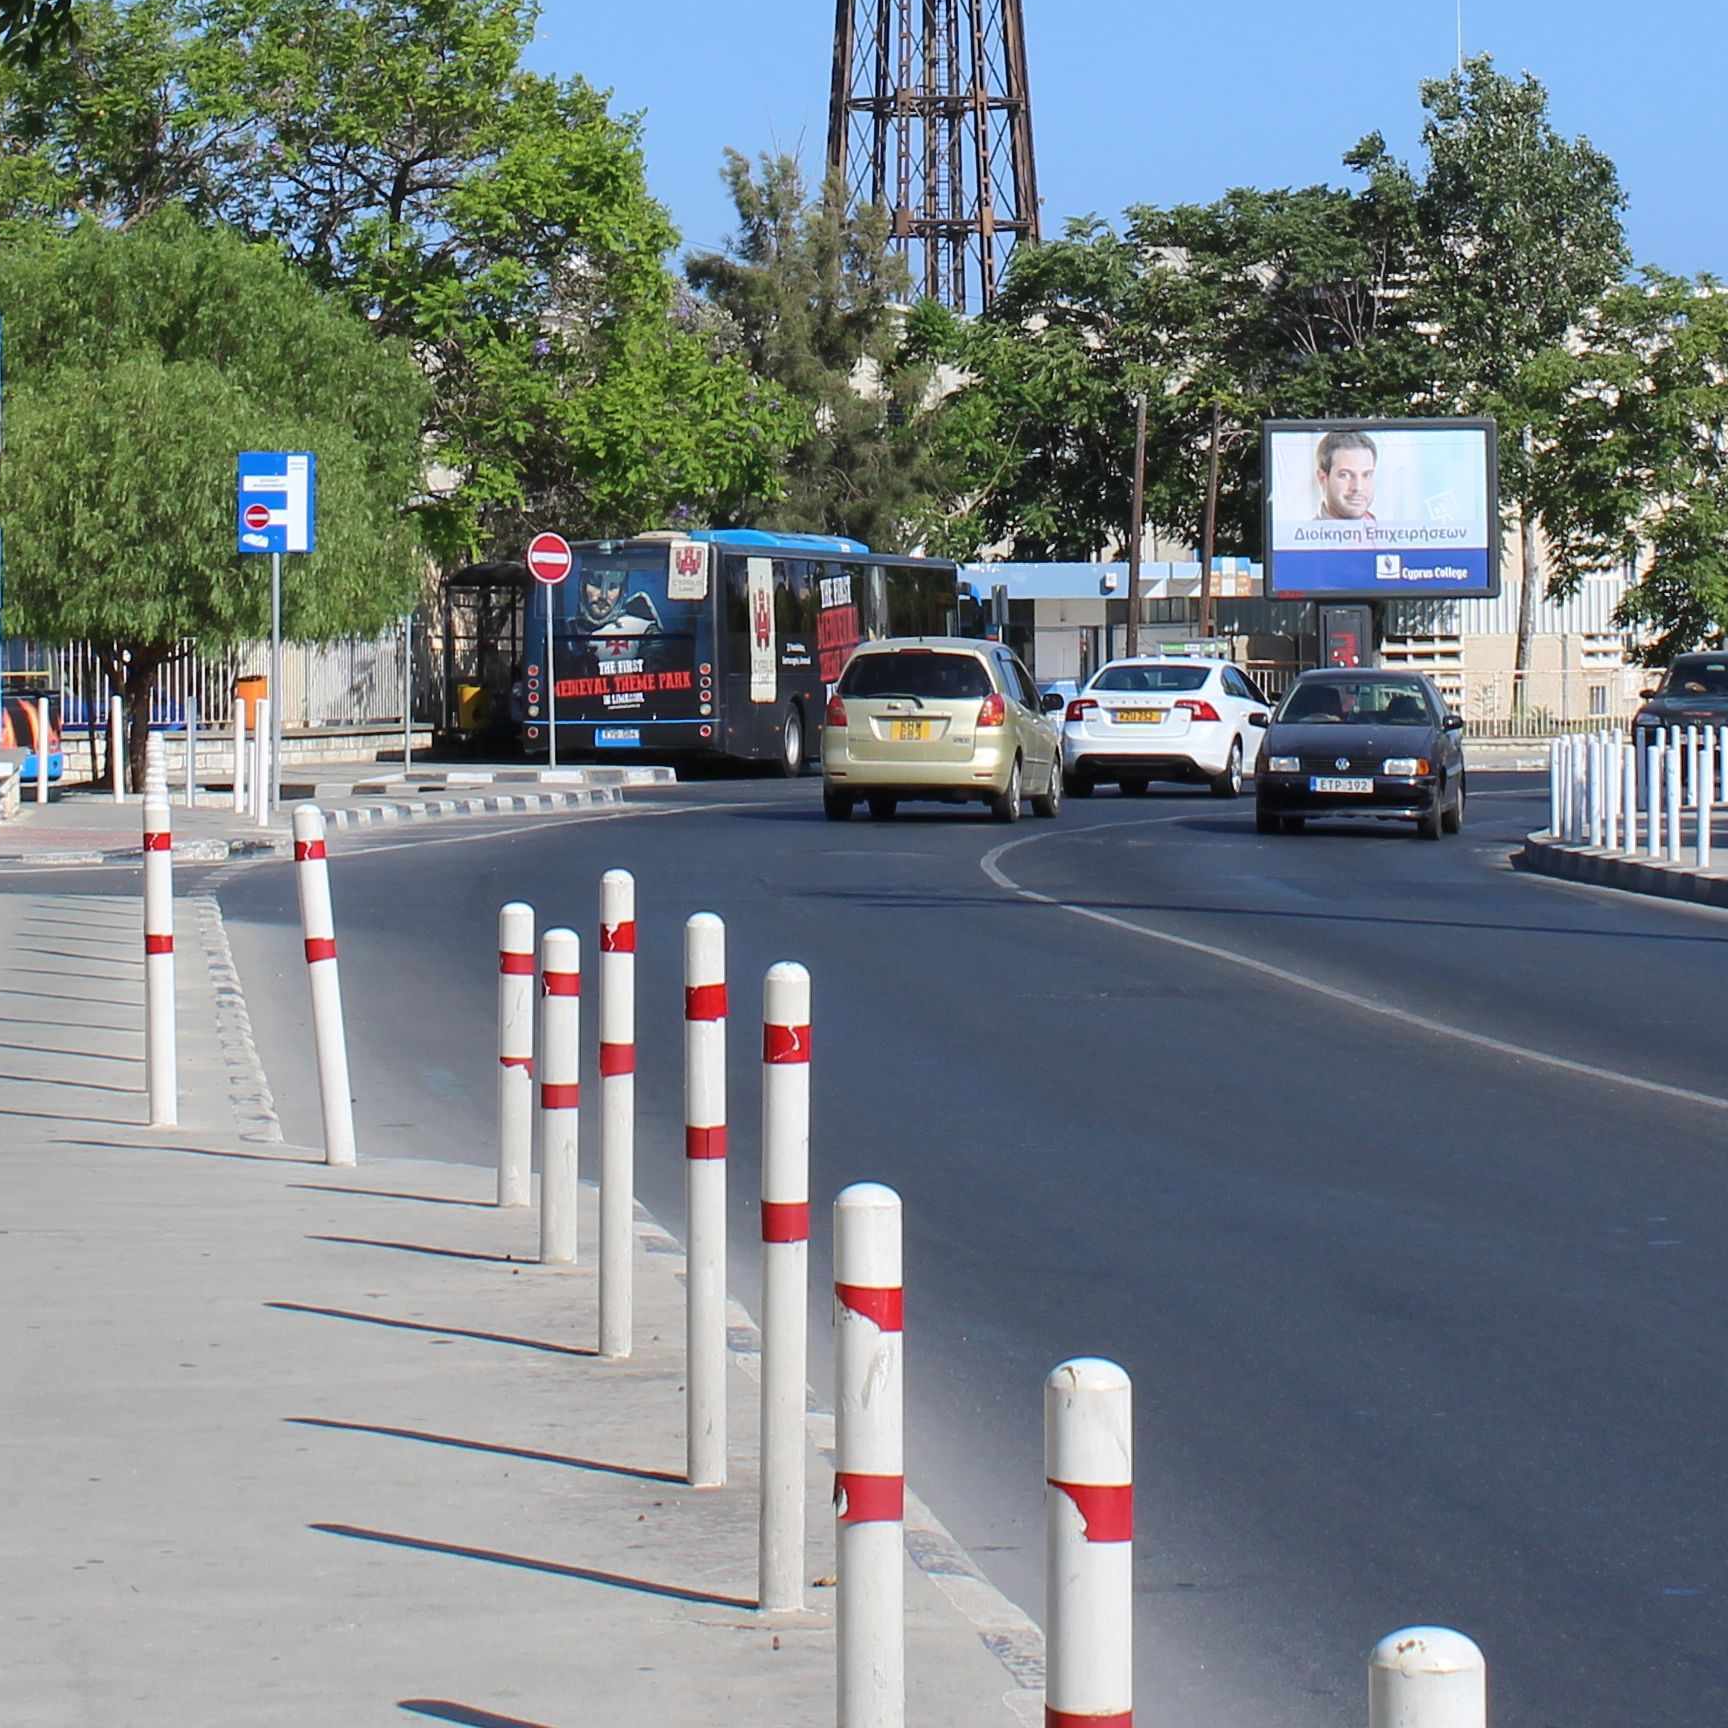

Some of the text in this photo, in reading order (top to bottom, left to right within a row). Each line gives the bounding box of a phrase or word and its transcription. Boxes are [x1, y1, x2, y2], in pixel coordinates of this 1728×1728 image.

[1294, 526, 1467, 543] Διοίκηση Επιχειρήσεων
[1402, 565, 1468, 581] Cyprus College
[598, 659, 644, 675] THE FIRST
[614, 673, 656, 693] THEME
[658, 671, 691, 689] PARK
